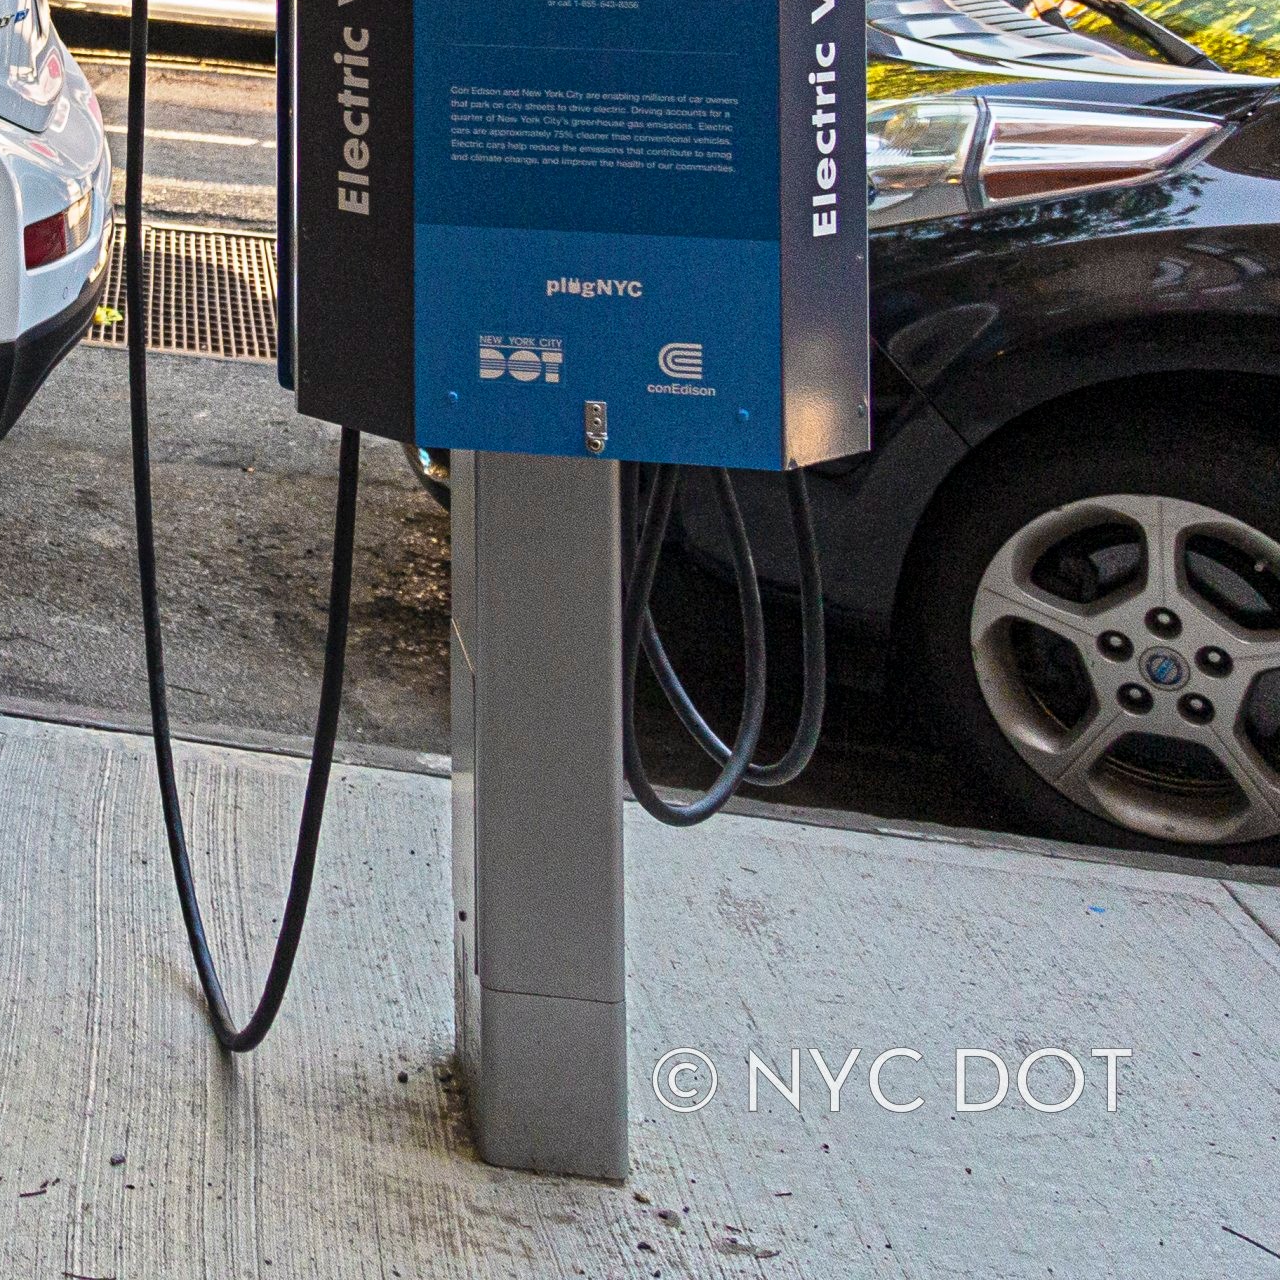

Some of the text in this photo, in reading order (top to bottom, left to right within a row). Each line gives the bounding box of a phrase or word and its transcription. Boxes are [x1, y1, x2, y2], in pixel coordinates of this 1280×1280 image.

[333, 26, 371, 216] Electric
[808, 41, 837, 238] Electric
[546, 277, 643, 298] plugNYC
[479, 335, 563, 348] NEW YORK CITY
[479, 348, 563, 383] DOT
[647, 382, 716, 397] conEdison
